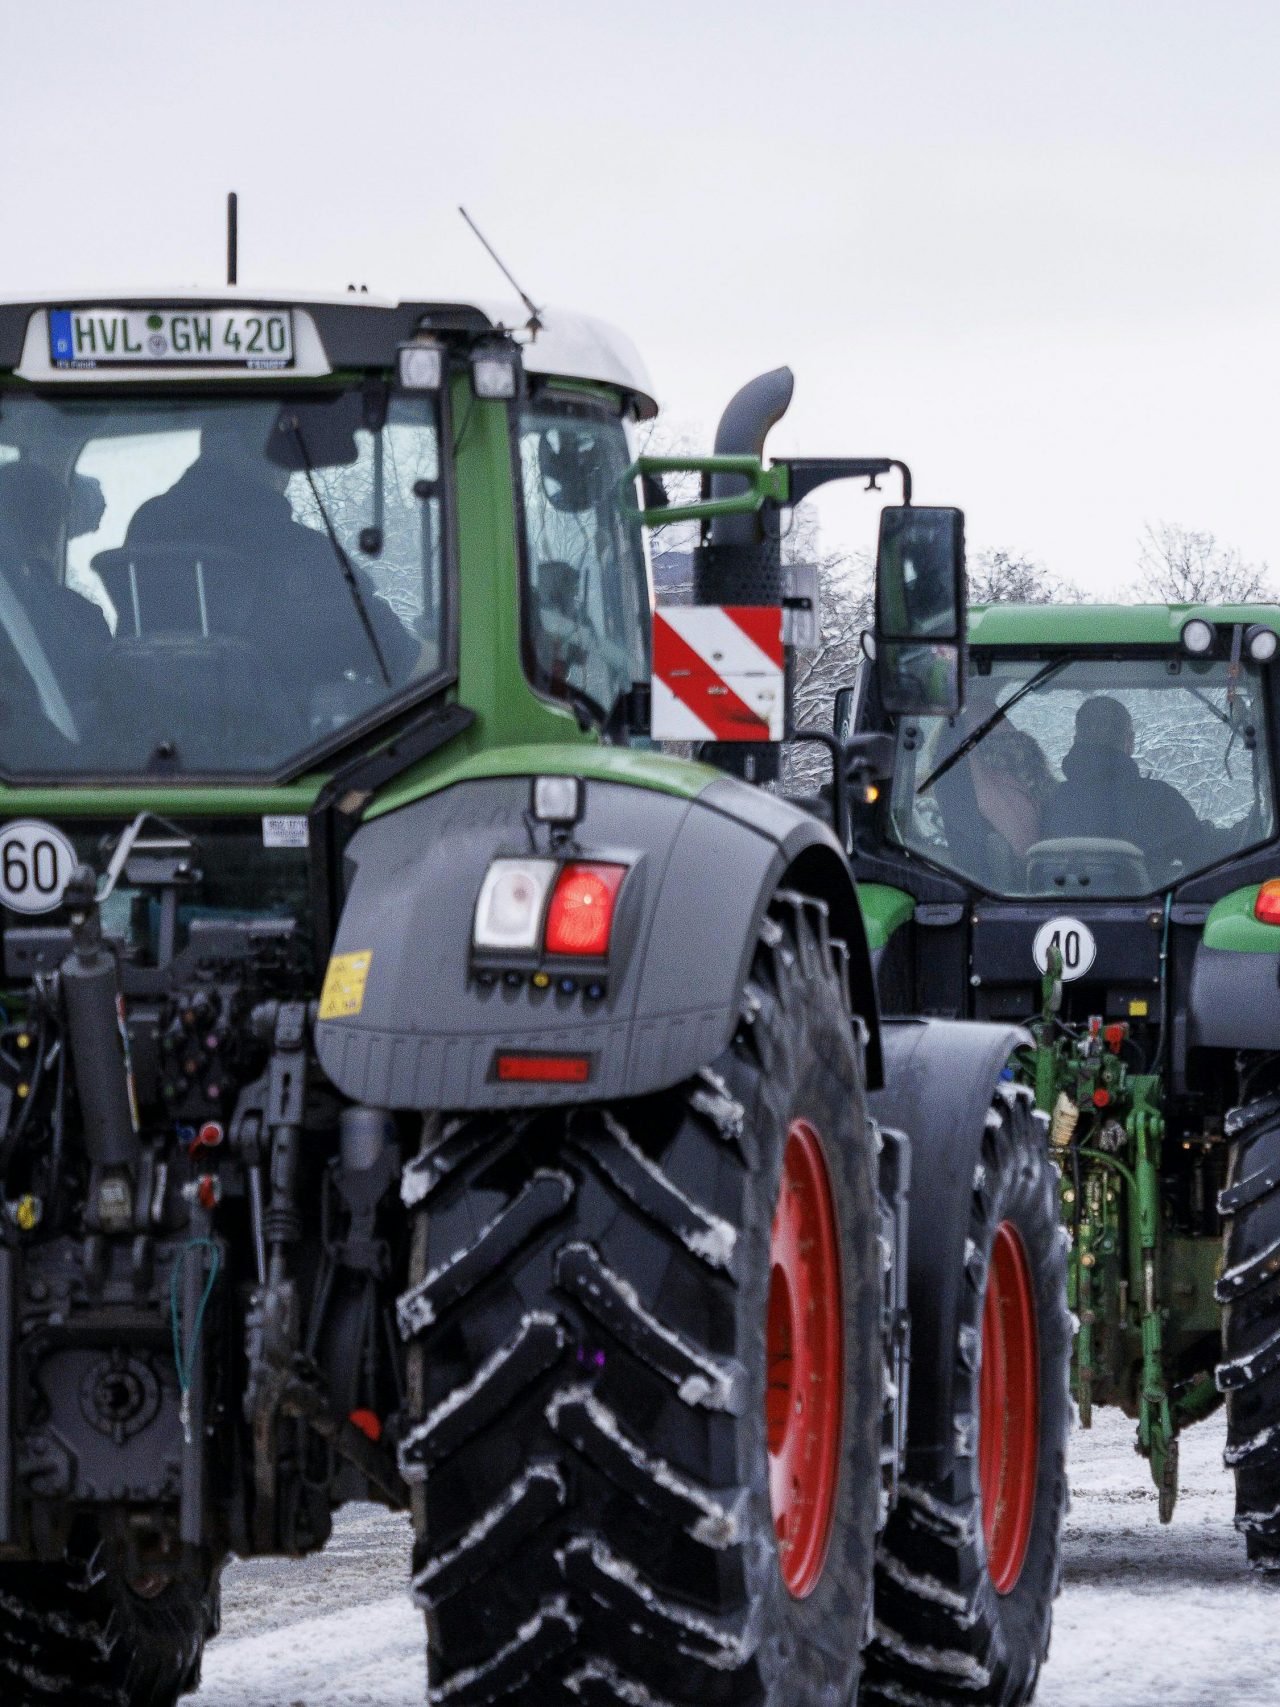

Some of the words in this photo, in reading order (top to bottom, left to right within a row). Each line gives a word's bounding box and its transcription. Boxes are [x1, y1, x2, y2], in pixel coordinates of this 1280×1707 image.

[74, 317, 143, 353] HVL
[170, 316, 212, 352] GW
[223, 317, 285, 352] 420
[3, 840, 58, 895] 60
